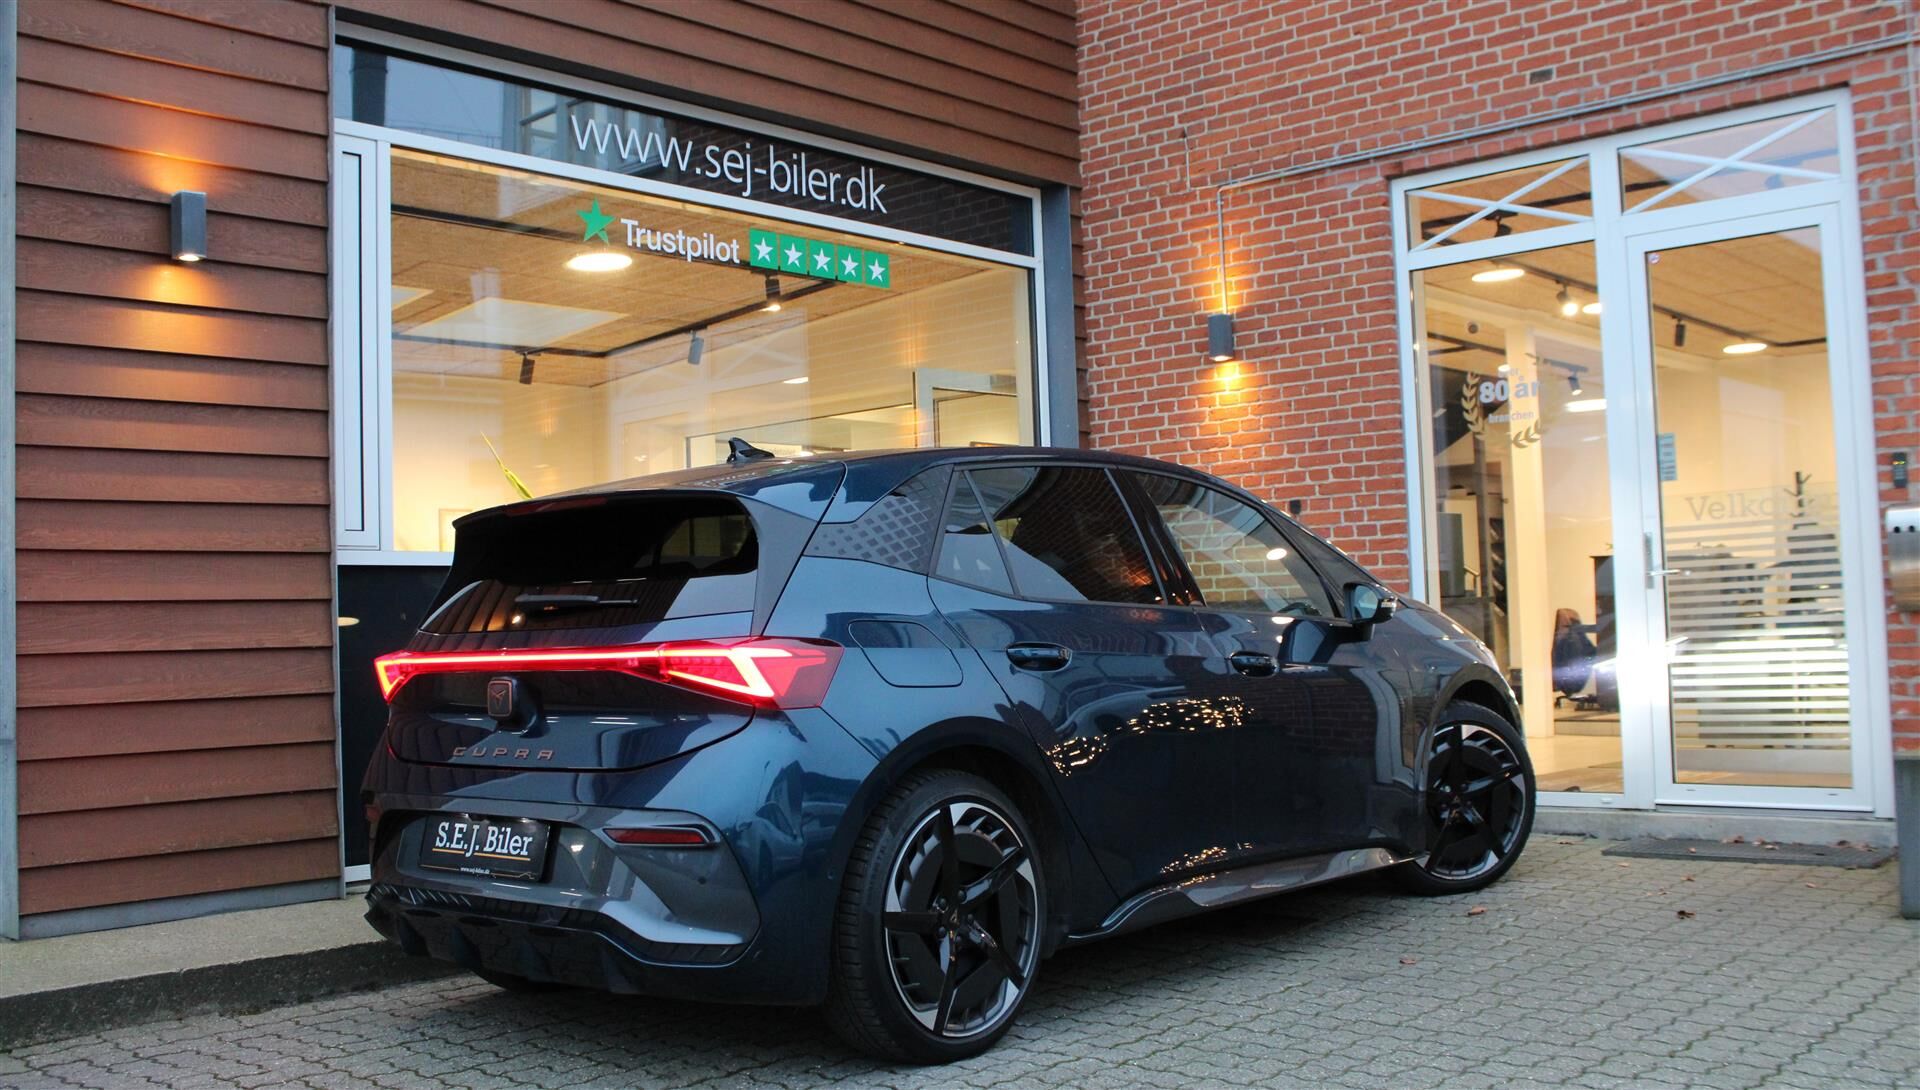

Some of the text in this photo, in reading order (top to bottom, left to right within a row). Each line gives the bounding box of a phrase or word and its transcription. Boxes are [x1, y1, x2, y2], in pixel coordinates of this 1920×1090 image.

[571, 115, 888, 214] www.sej-biler.dk
[620, 218, 740, 263] Trustpilot
[1479, 376, 1543, 403] 80 år
[453, 747, 554, 760] CUPRA
[436, 822, 534, 857] S.E.J. Biler
